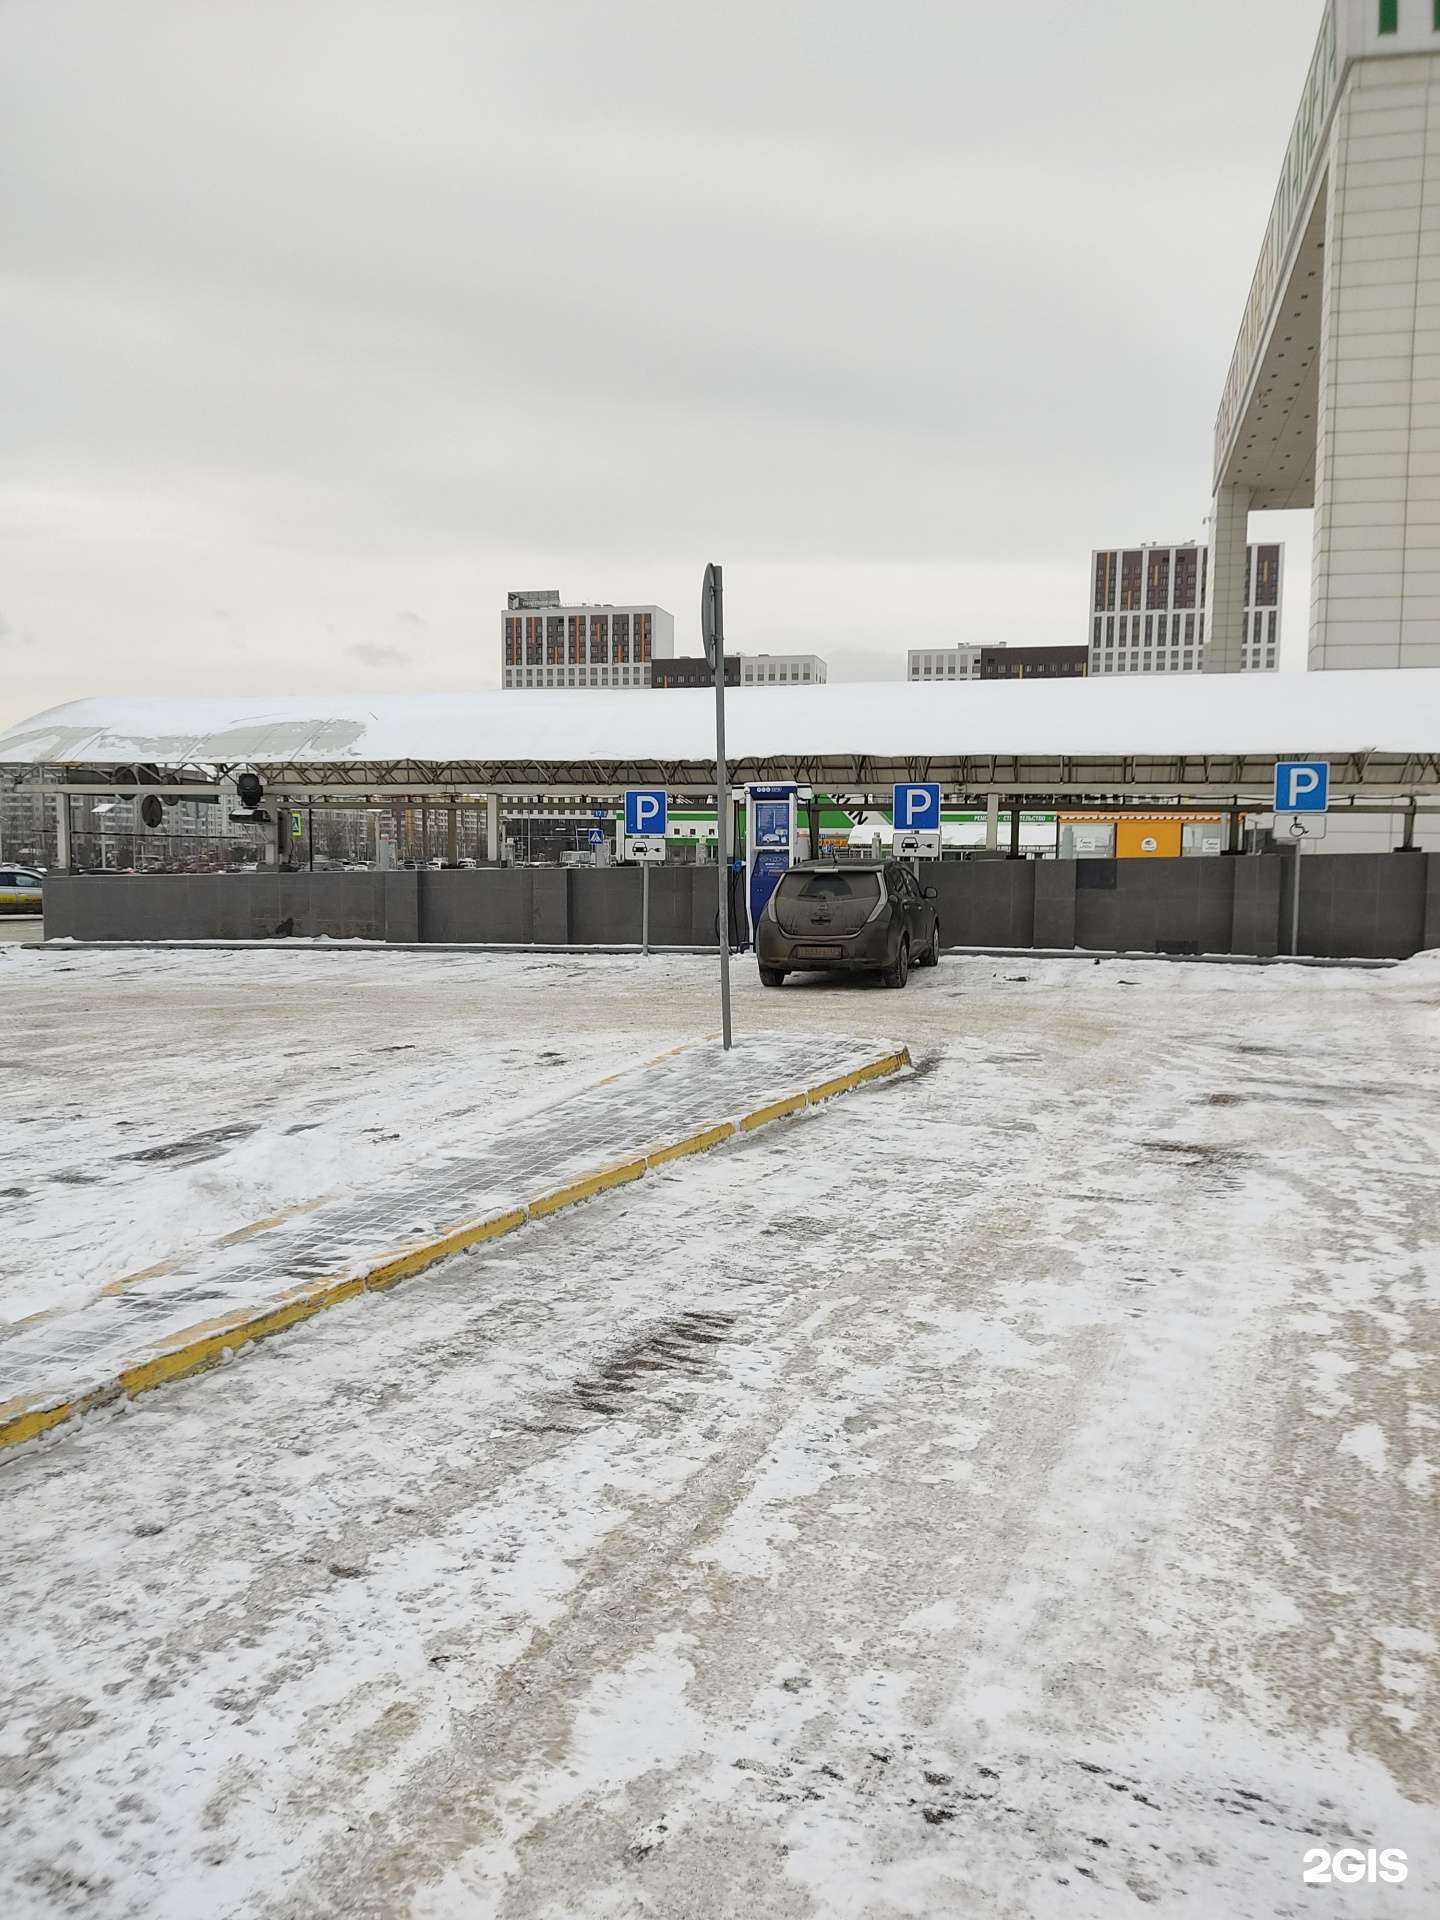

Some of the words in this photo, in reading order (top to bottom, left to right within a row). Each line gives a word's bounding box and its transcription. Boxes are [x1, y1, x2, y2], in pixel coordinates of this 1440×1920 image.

[1289, 768, 1319, 806] P
[636, 795, 659, 830] P
[906, 788, 932, 825] P
